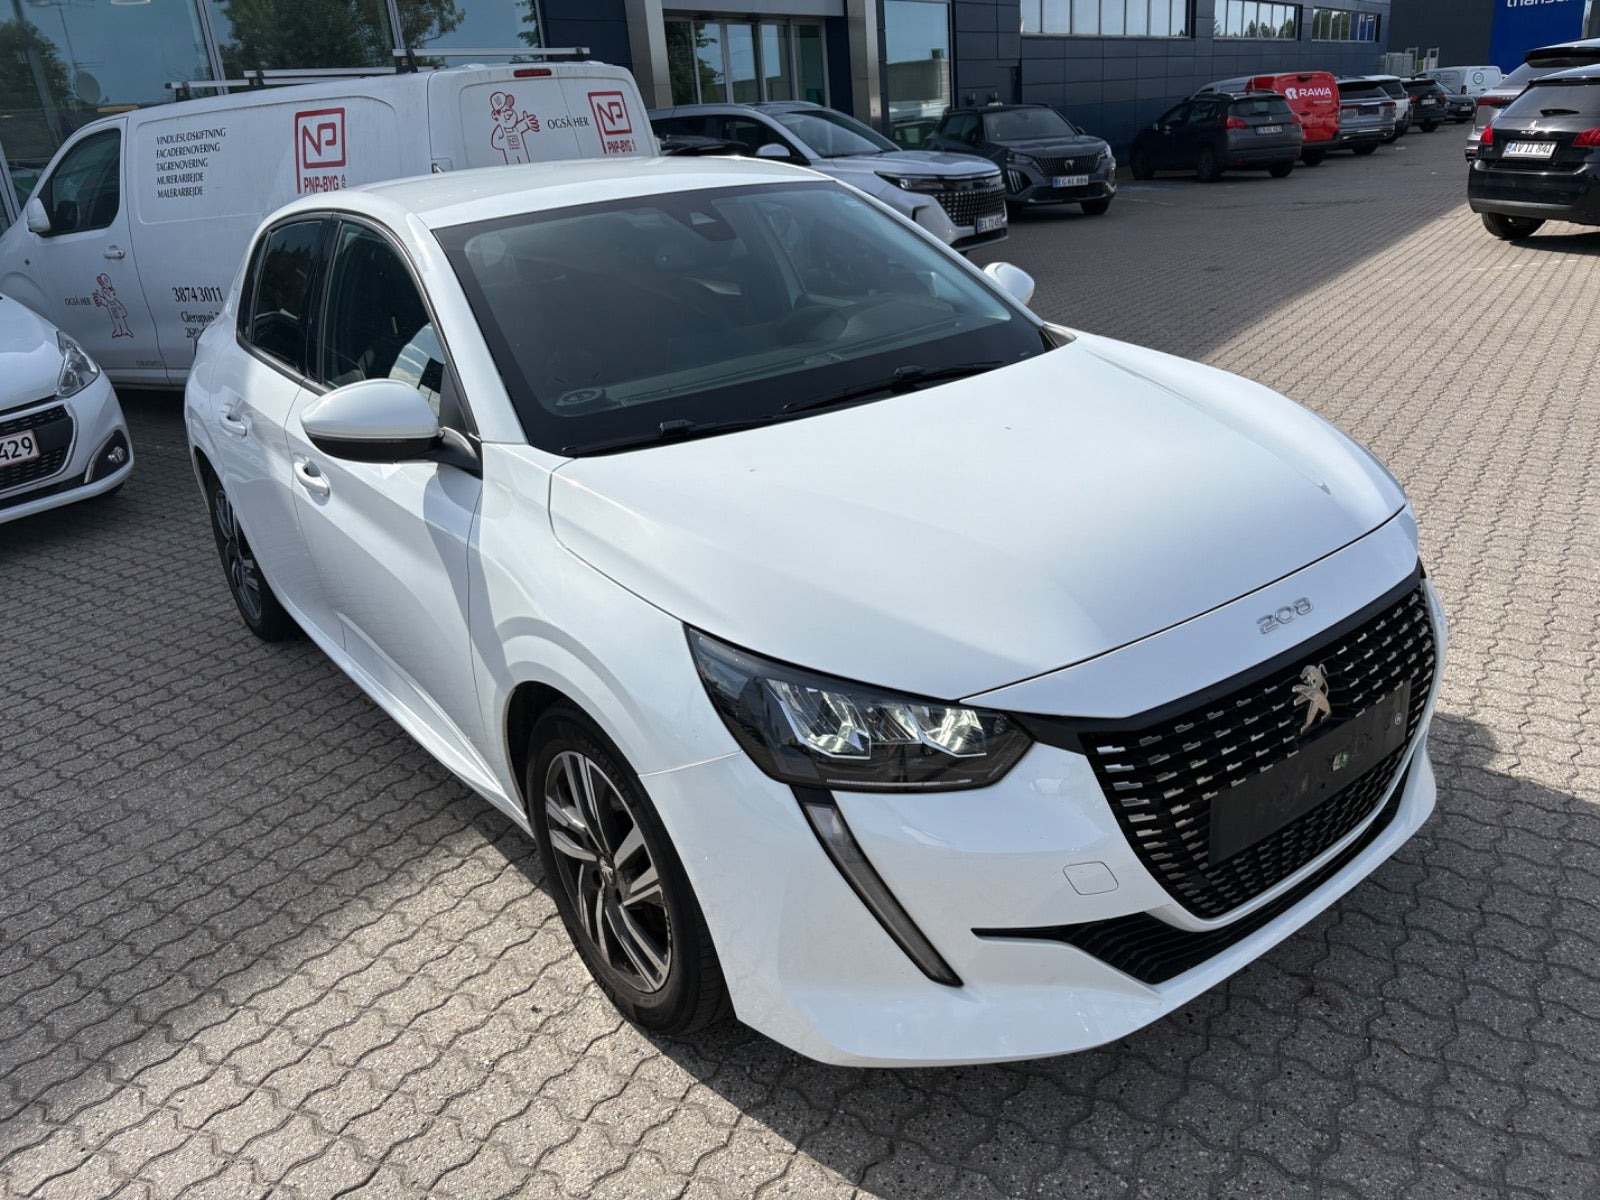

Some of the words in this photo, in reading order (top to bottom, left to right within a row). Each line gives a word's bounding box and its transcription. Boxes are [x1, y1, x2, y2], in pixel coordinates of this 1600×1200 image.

[1299, 87, 1332, 97] RAWA
[547, 115, 573, 129] OGSÅ
[573, 116, 590, 128] HER
[156, 142, 220, 159] FACADERENOVERING
[156, 157, 208, 172] TAGRENOVERING
[156, 172, 204, 186] MURERARBEJDE
[303, 175, 339, 194] PNP-BYG
[157, 186, 204, 199] MALERARBEJDE
[0, 436, 33, 460] 429
[1256, 597, 1313, 635] 208
